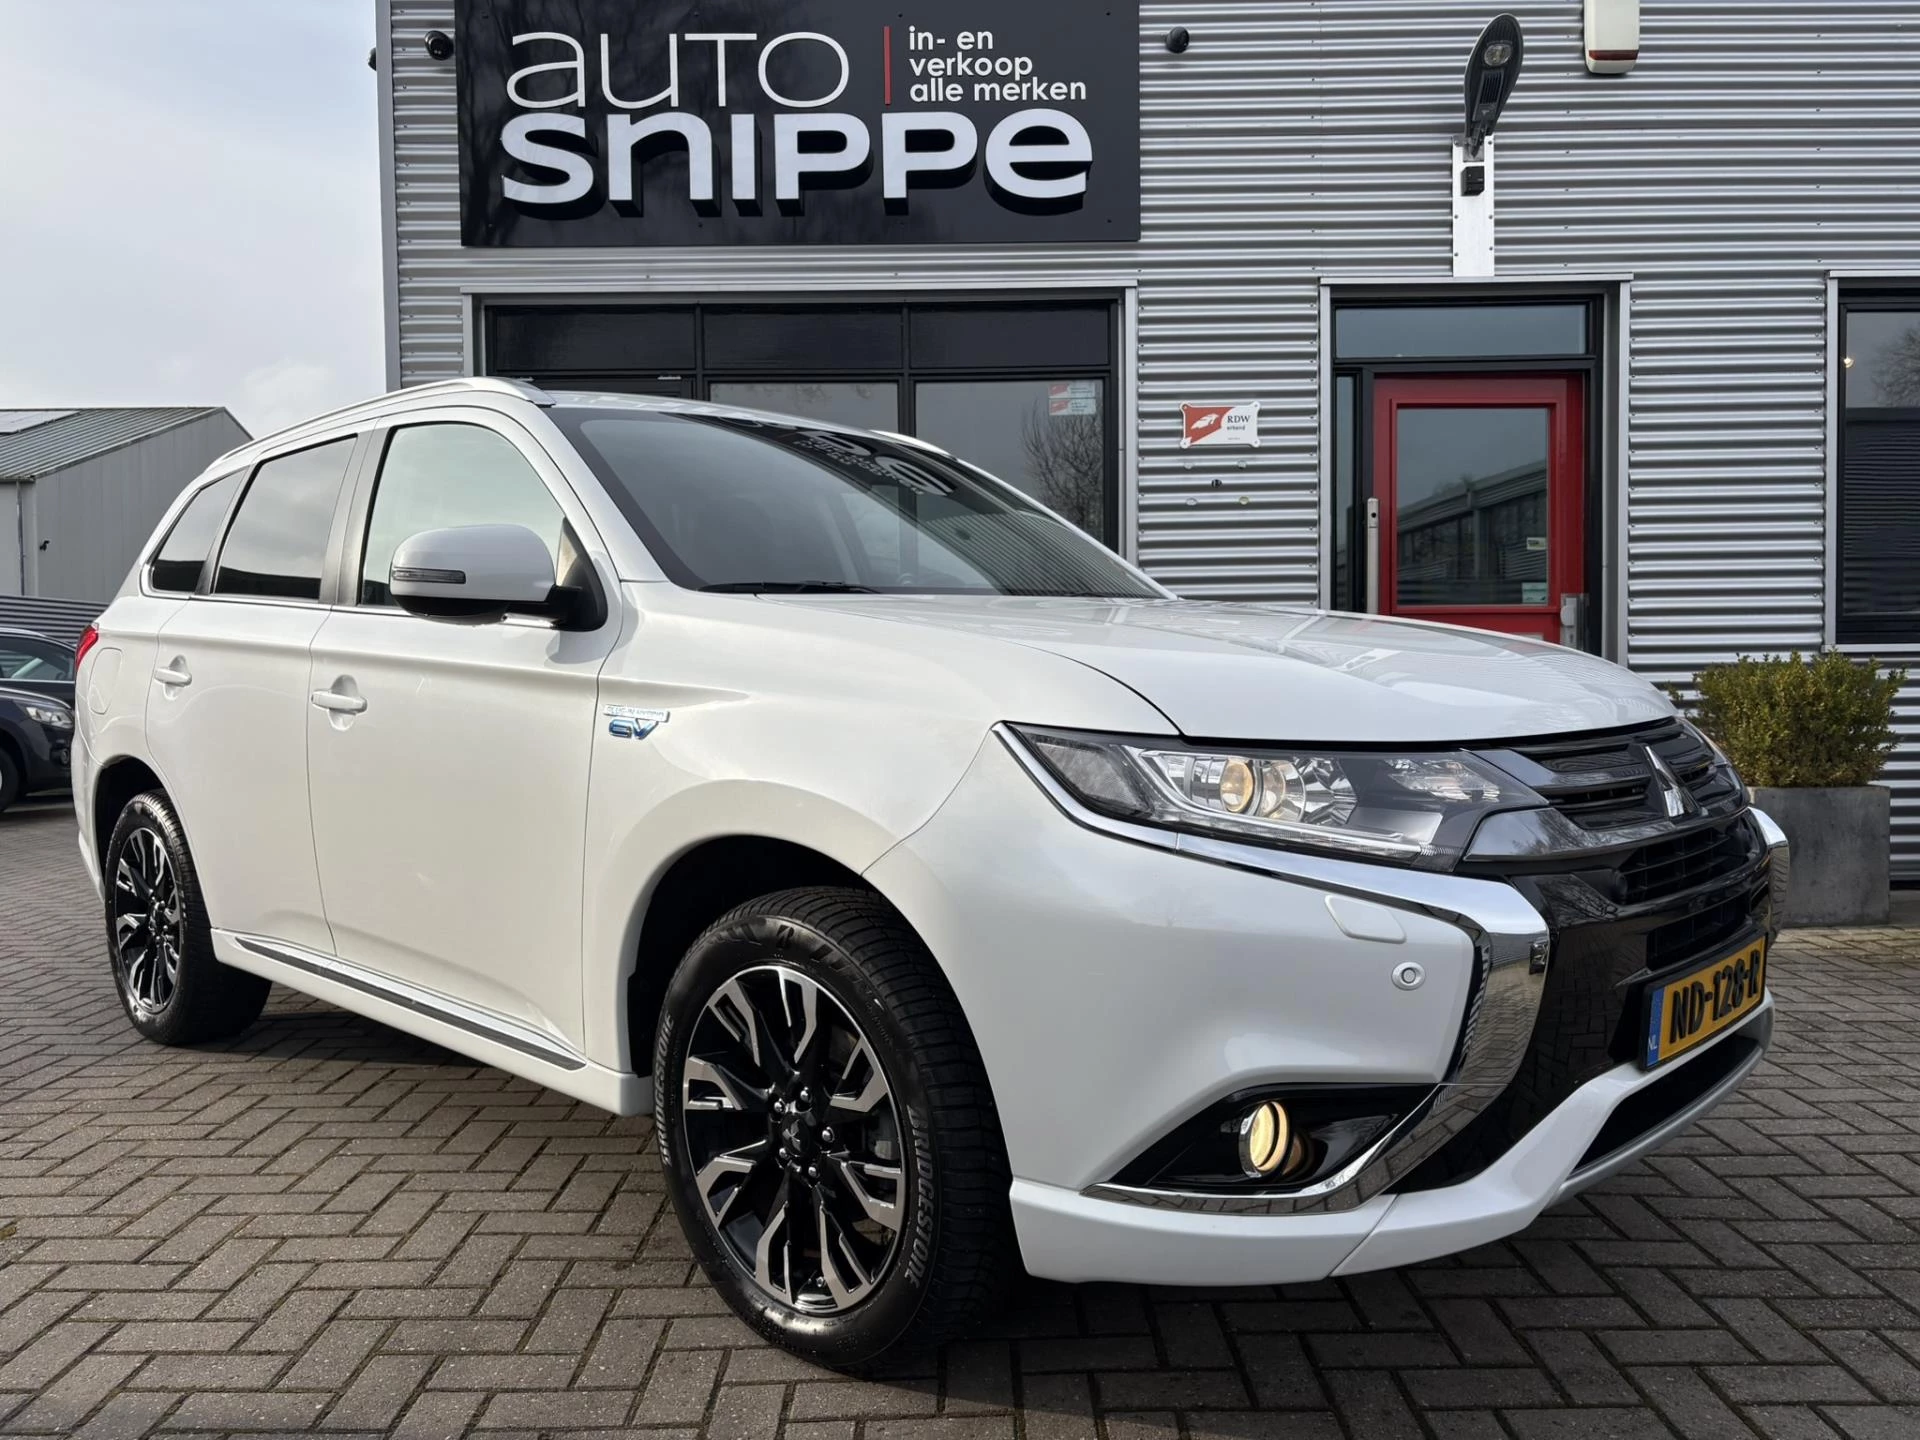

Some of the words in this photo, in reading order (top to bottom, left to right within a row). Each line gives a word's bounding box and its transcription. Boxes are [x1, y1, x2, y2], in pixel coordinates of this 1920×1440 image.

[908, 25, 945, 50] in-
[956, 28, 995, 50] en
[908, 53, 1034, 79] verkoop
[909, 77, 965, 103] alle
[973, 78, 1087, 102] merken
[1227, 415, 1251, 424] RDW
[1669, 949, 1761, 1044] ND-128-R
[654, 1011, 675, 1168] BRIDGESTONE
[905, 1104, 935, 1289] BRIDGESTONE
